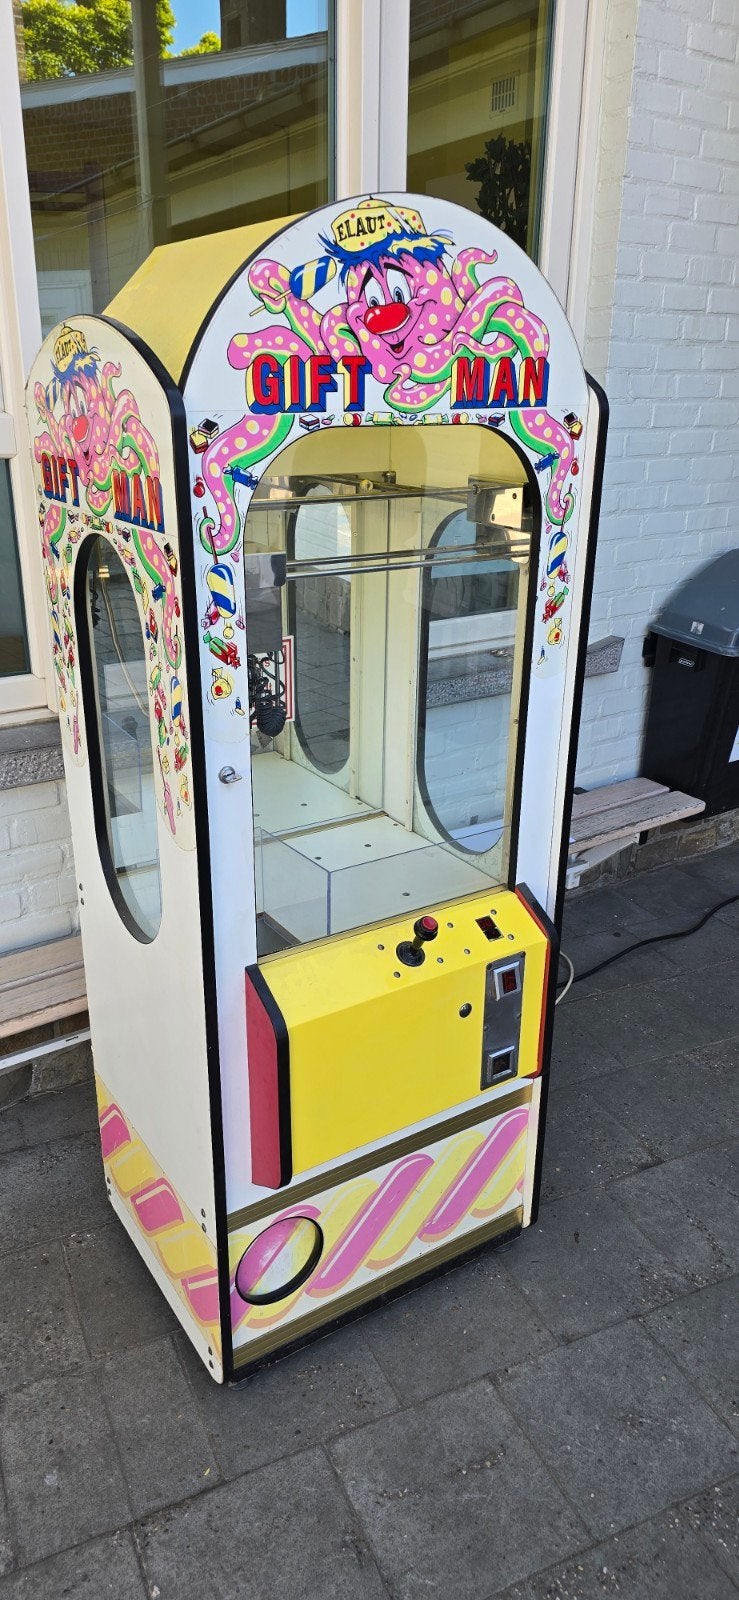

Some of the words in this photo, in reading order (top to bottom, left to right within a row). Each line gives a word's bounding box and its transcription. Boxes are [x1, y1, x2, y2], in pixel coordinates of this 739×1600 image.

[336, 214, 385, 242] ELAUT
[246, 355, 372, 414] GIFT
[450, 357, 549, 409] MAN
[41, 453, 80, 507] GIFT
[111, 468, 165, 534] MAN
